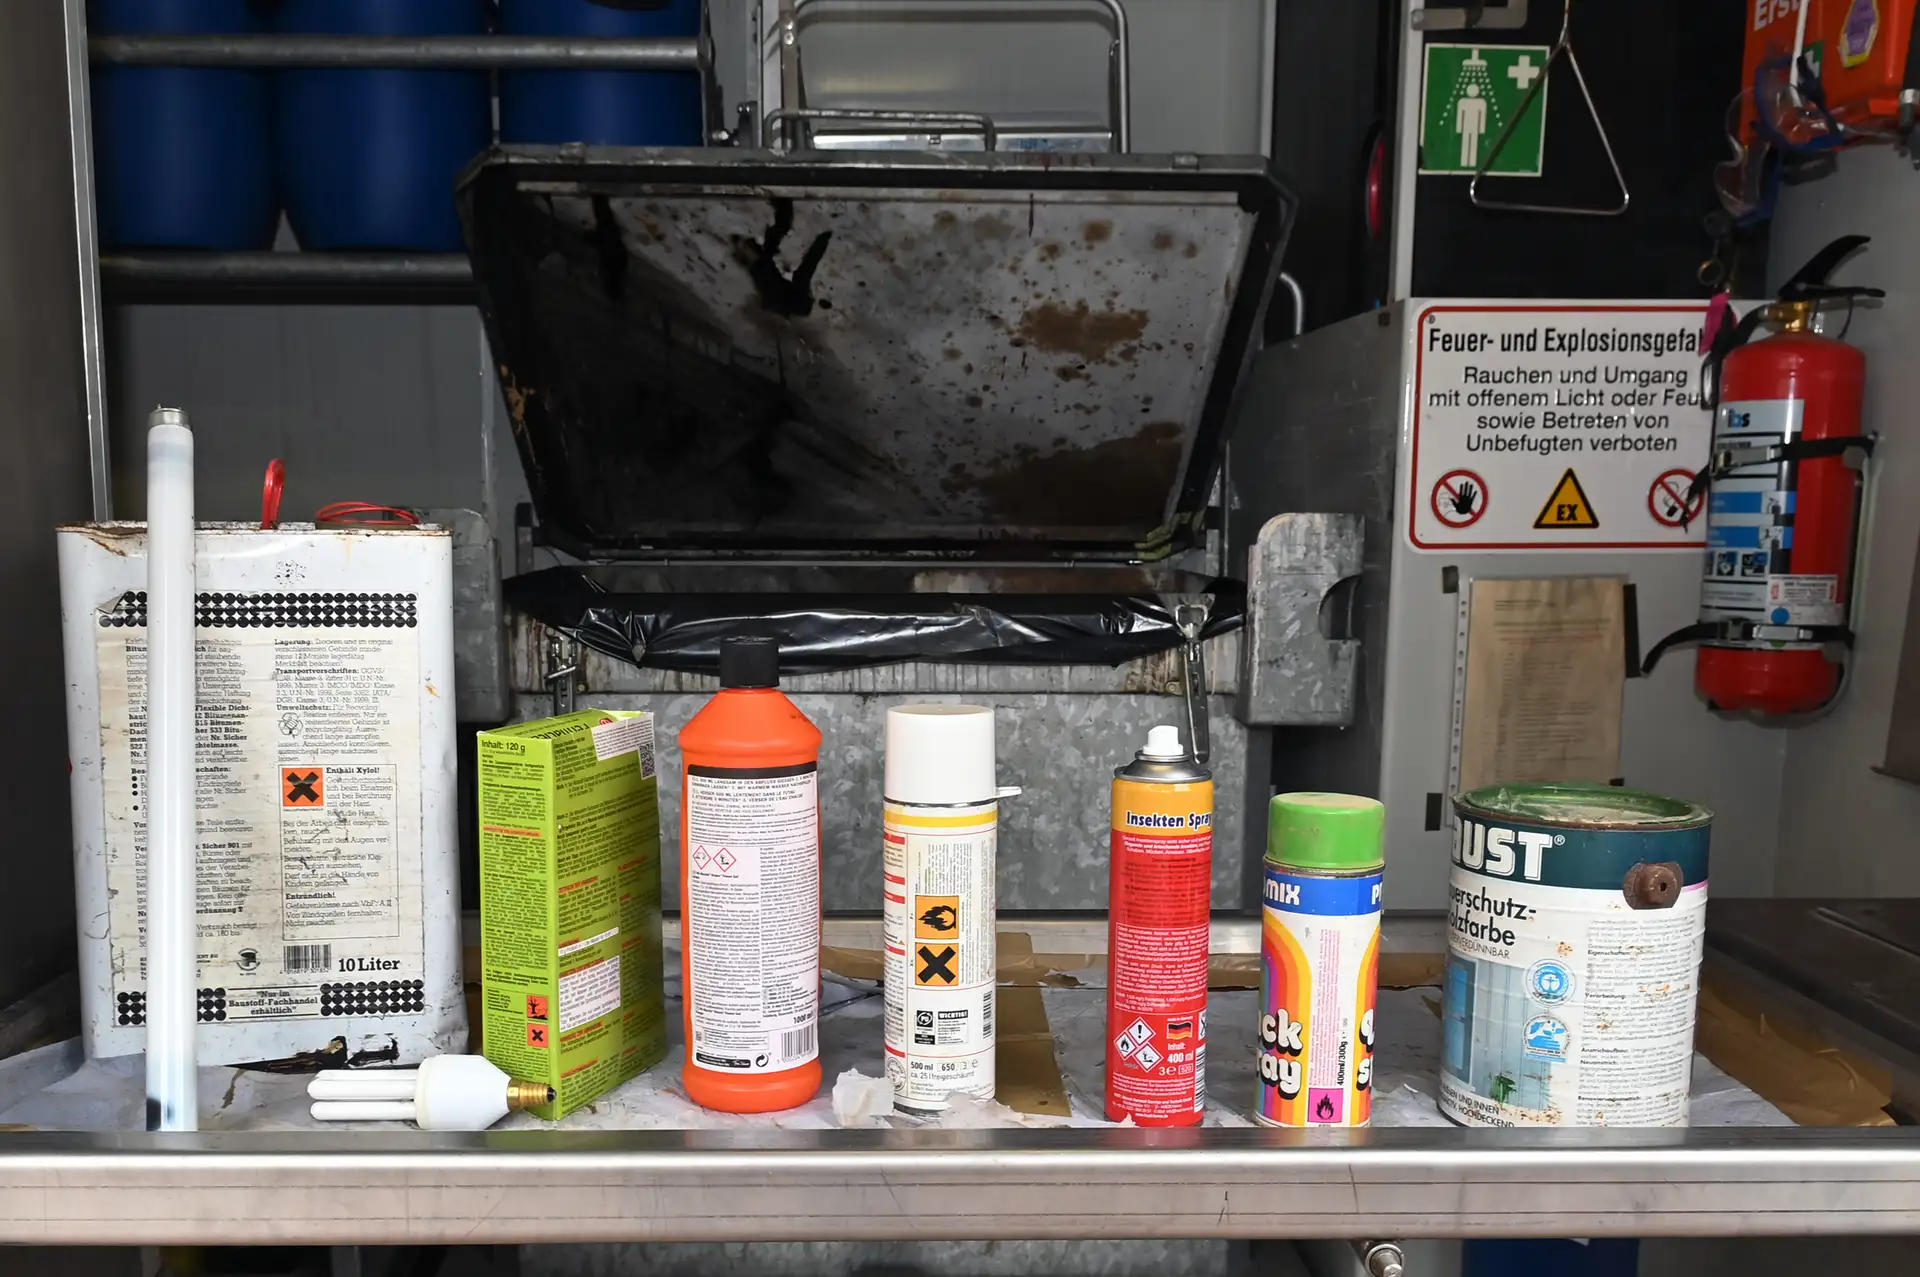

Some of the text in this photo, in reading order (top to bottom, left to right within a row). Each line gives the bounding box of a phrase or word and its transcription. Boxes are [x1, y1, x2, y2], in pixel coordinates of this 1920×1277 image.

[1429, 328, 1494, 352] Feuer-
[1501, 328, 1537, 352] und
[1464, 366, 1687, 387] Rauchen und Umgang
[1429, 390, 1460, 406] mit
[1467, 389, 1548, 407] offenem
[1555, 389, 1604, 406] Licht
[1611, 389, 1657, 406] oder
[1477, 412, 1669, 429] sowie Betreten von
[1467, 434, 1677, 455] Unbefugten verboten
[1556, 504, 1578, 521] EX
[224, 690, 251, 698] Haftung
[482, 740, 526, 753] Inhalt: 120 g
[356, 767, 380, 775] Xylol!
[1126, 811, 1184, 828] Insekten
[302, 911, 346, 919] Zündquellen
[338, 958, 400, 972] 10 Liter
[228, 996, 318, 1008] Baustoff-Fachhandel
[939, 1011, 968, 1019] WICHTIG!
[1167, 1051, 1194, 1064] 400 ml
[911, 1061, 923, 1071] 500
[924, 1062, 934, 1071] ml
[941, 1063, 955, 1072] 650
[931, 1071, 975, 1081] freigeschäumt
